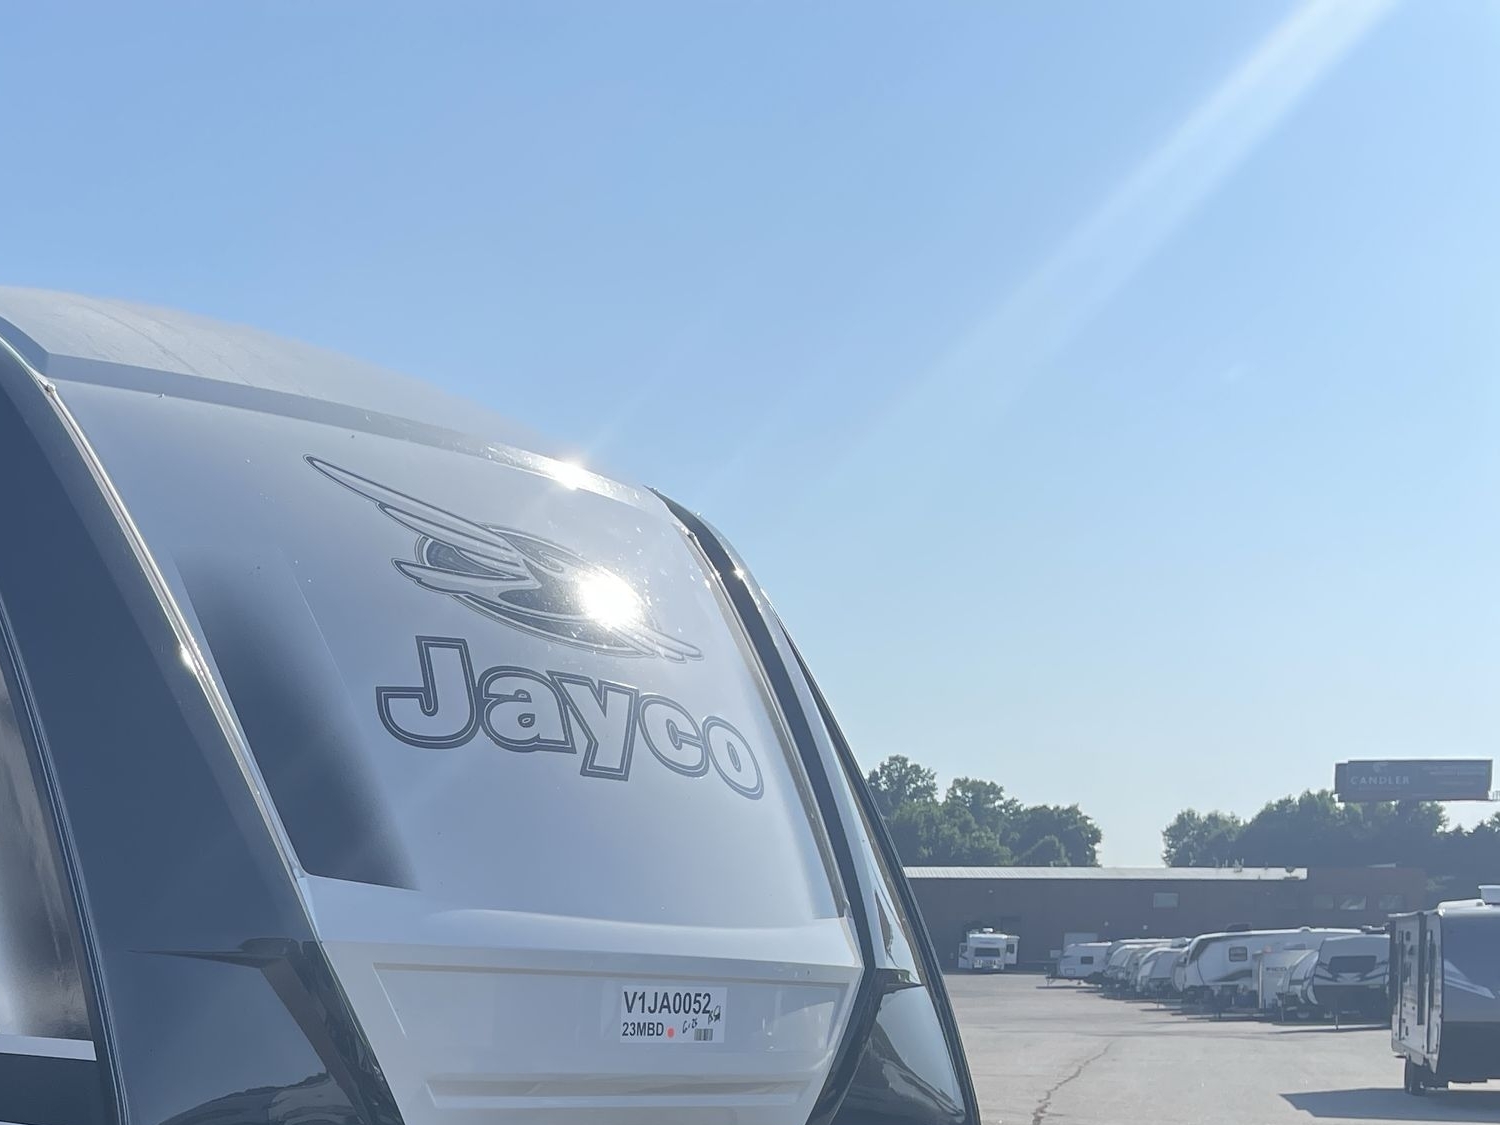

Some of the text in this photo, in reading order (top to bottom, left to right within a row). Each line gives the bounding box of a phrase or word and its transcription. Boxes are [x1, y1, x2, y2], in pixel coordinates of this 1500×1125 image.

[375, 635, 764, 800] Jayco
[623, 991, 711, 1014] V1JA0052
[621, 1022, 664, 1037] 23MBD
